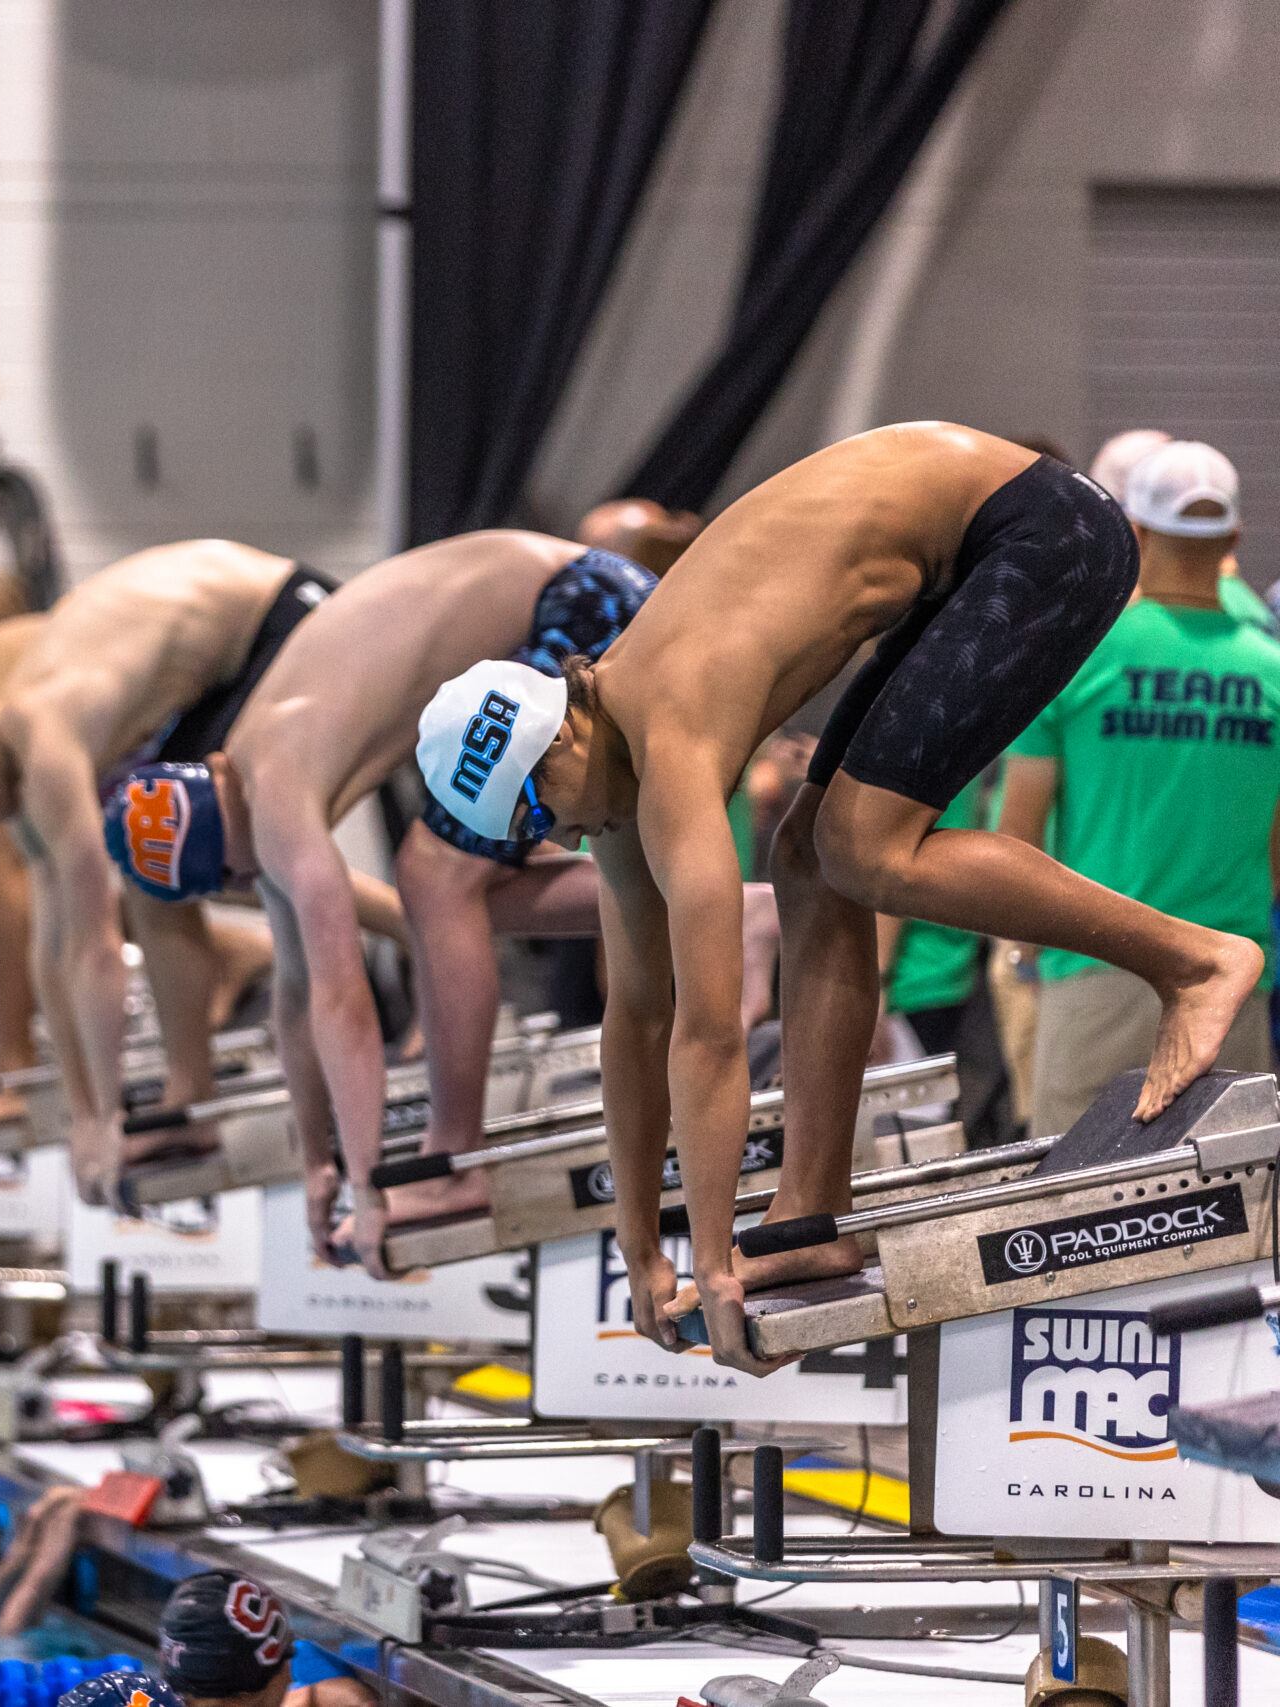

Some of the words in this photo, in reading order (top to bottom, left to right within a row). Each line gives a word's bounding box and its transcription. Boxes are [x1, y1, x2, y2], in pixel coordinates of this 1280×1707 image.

[1124, 666, 1263, 708] TEAM
[450, 690, 520, 803] MSA
[1102, 710, 1206, 741] SWIM
[1050, 1201, 1225, 1255] PADDOCK
[1061, 1251, 1092, 1264] POOL
[1095, 1236, 1159, 1258] EQUIPMENT
[1162, 1224, 1216, 1243] COMPANY
[1023, 1317, 1170, 1364] SWIM
[594, 1372, 738, 1388] CAROLINA
[1021, 1365, 1170, 1439] MAC
[1007, 1483, 1177, 1501] CAROLINA
[1056, 1592, 1069, 1668] 5
